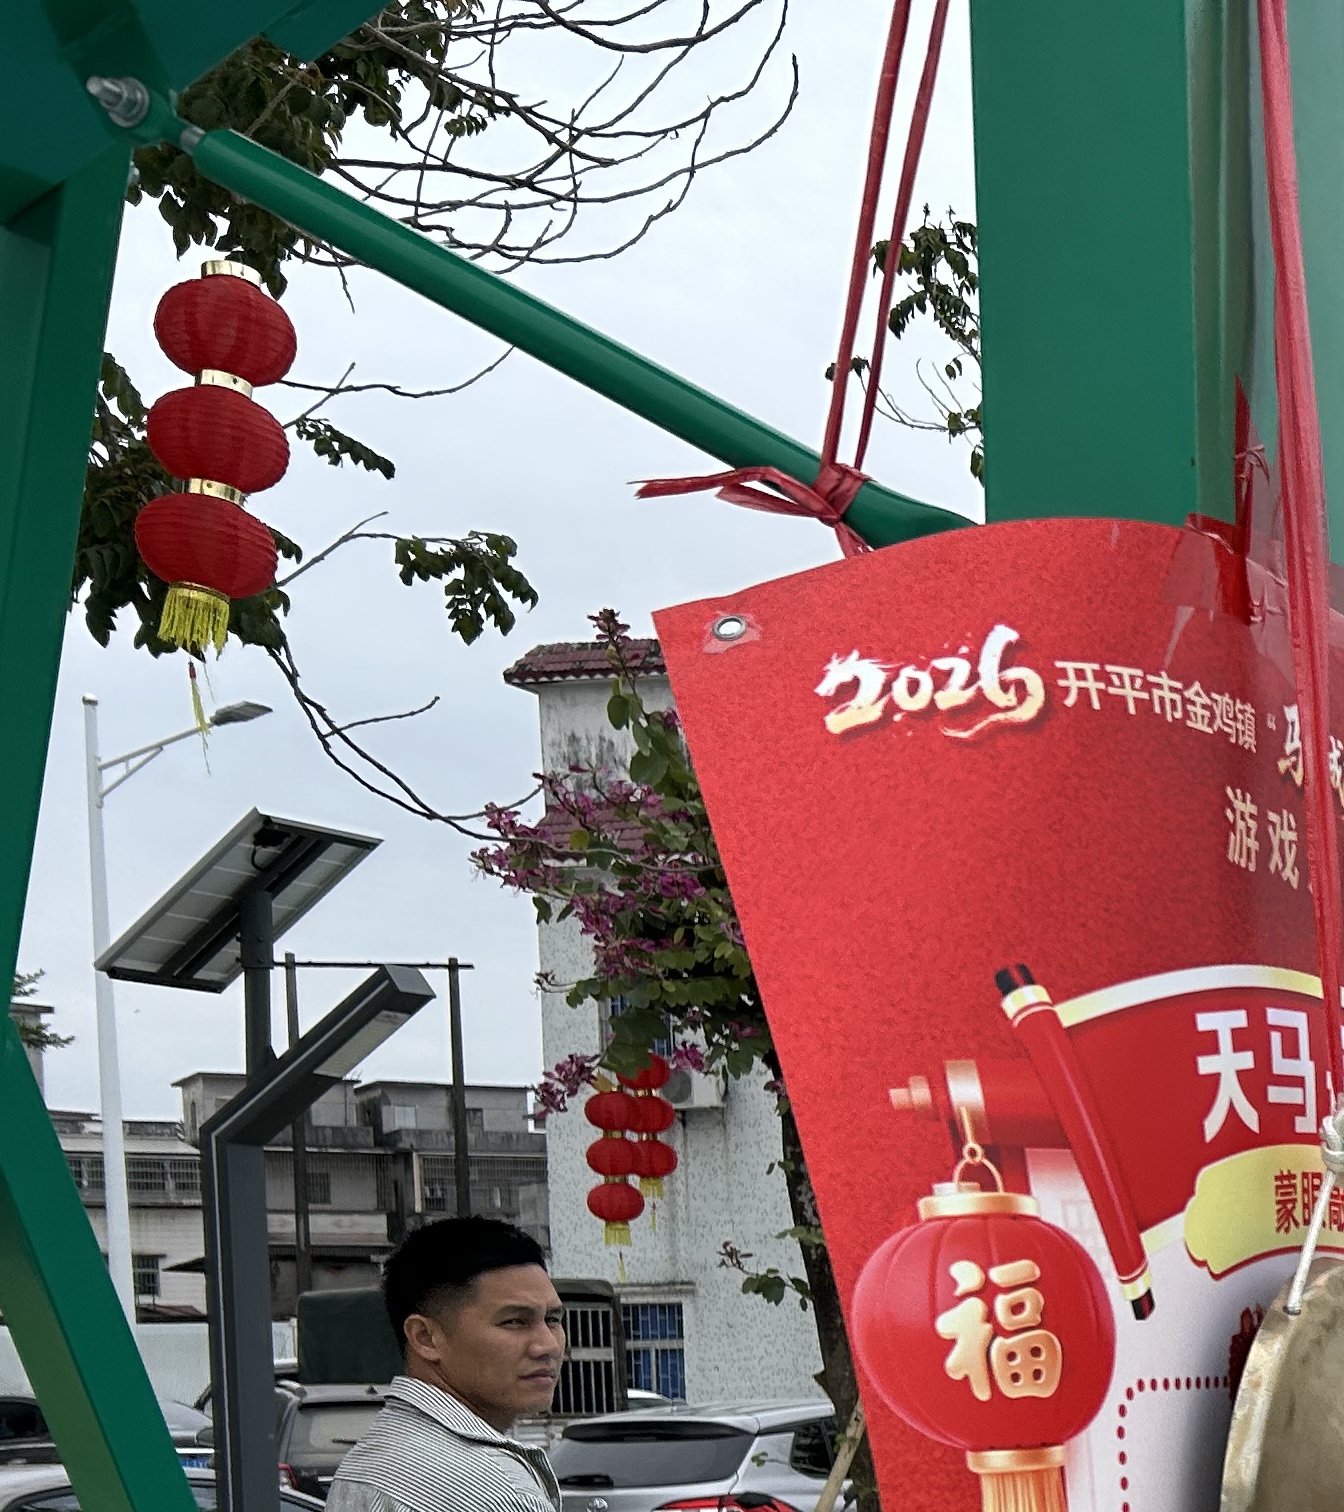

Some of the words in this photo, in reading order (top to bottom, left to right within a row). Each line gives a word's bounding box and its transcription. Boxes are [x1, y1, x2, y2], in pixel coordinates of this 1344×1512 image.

[812, 623, 1047, 739] 2026
[1055, 660, 1257, 754] 开平市金鸡镇
[935, 1258, 1064, 1402] 福
